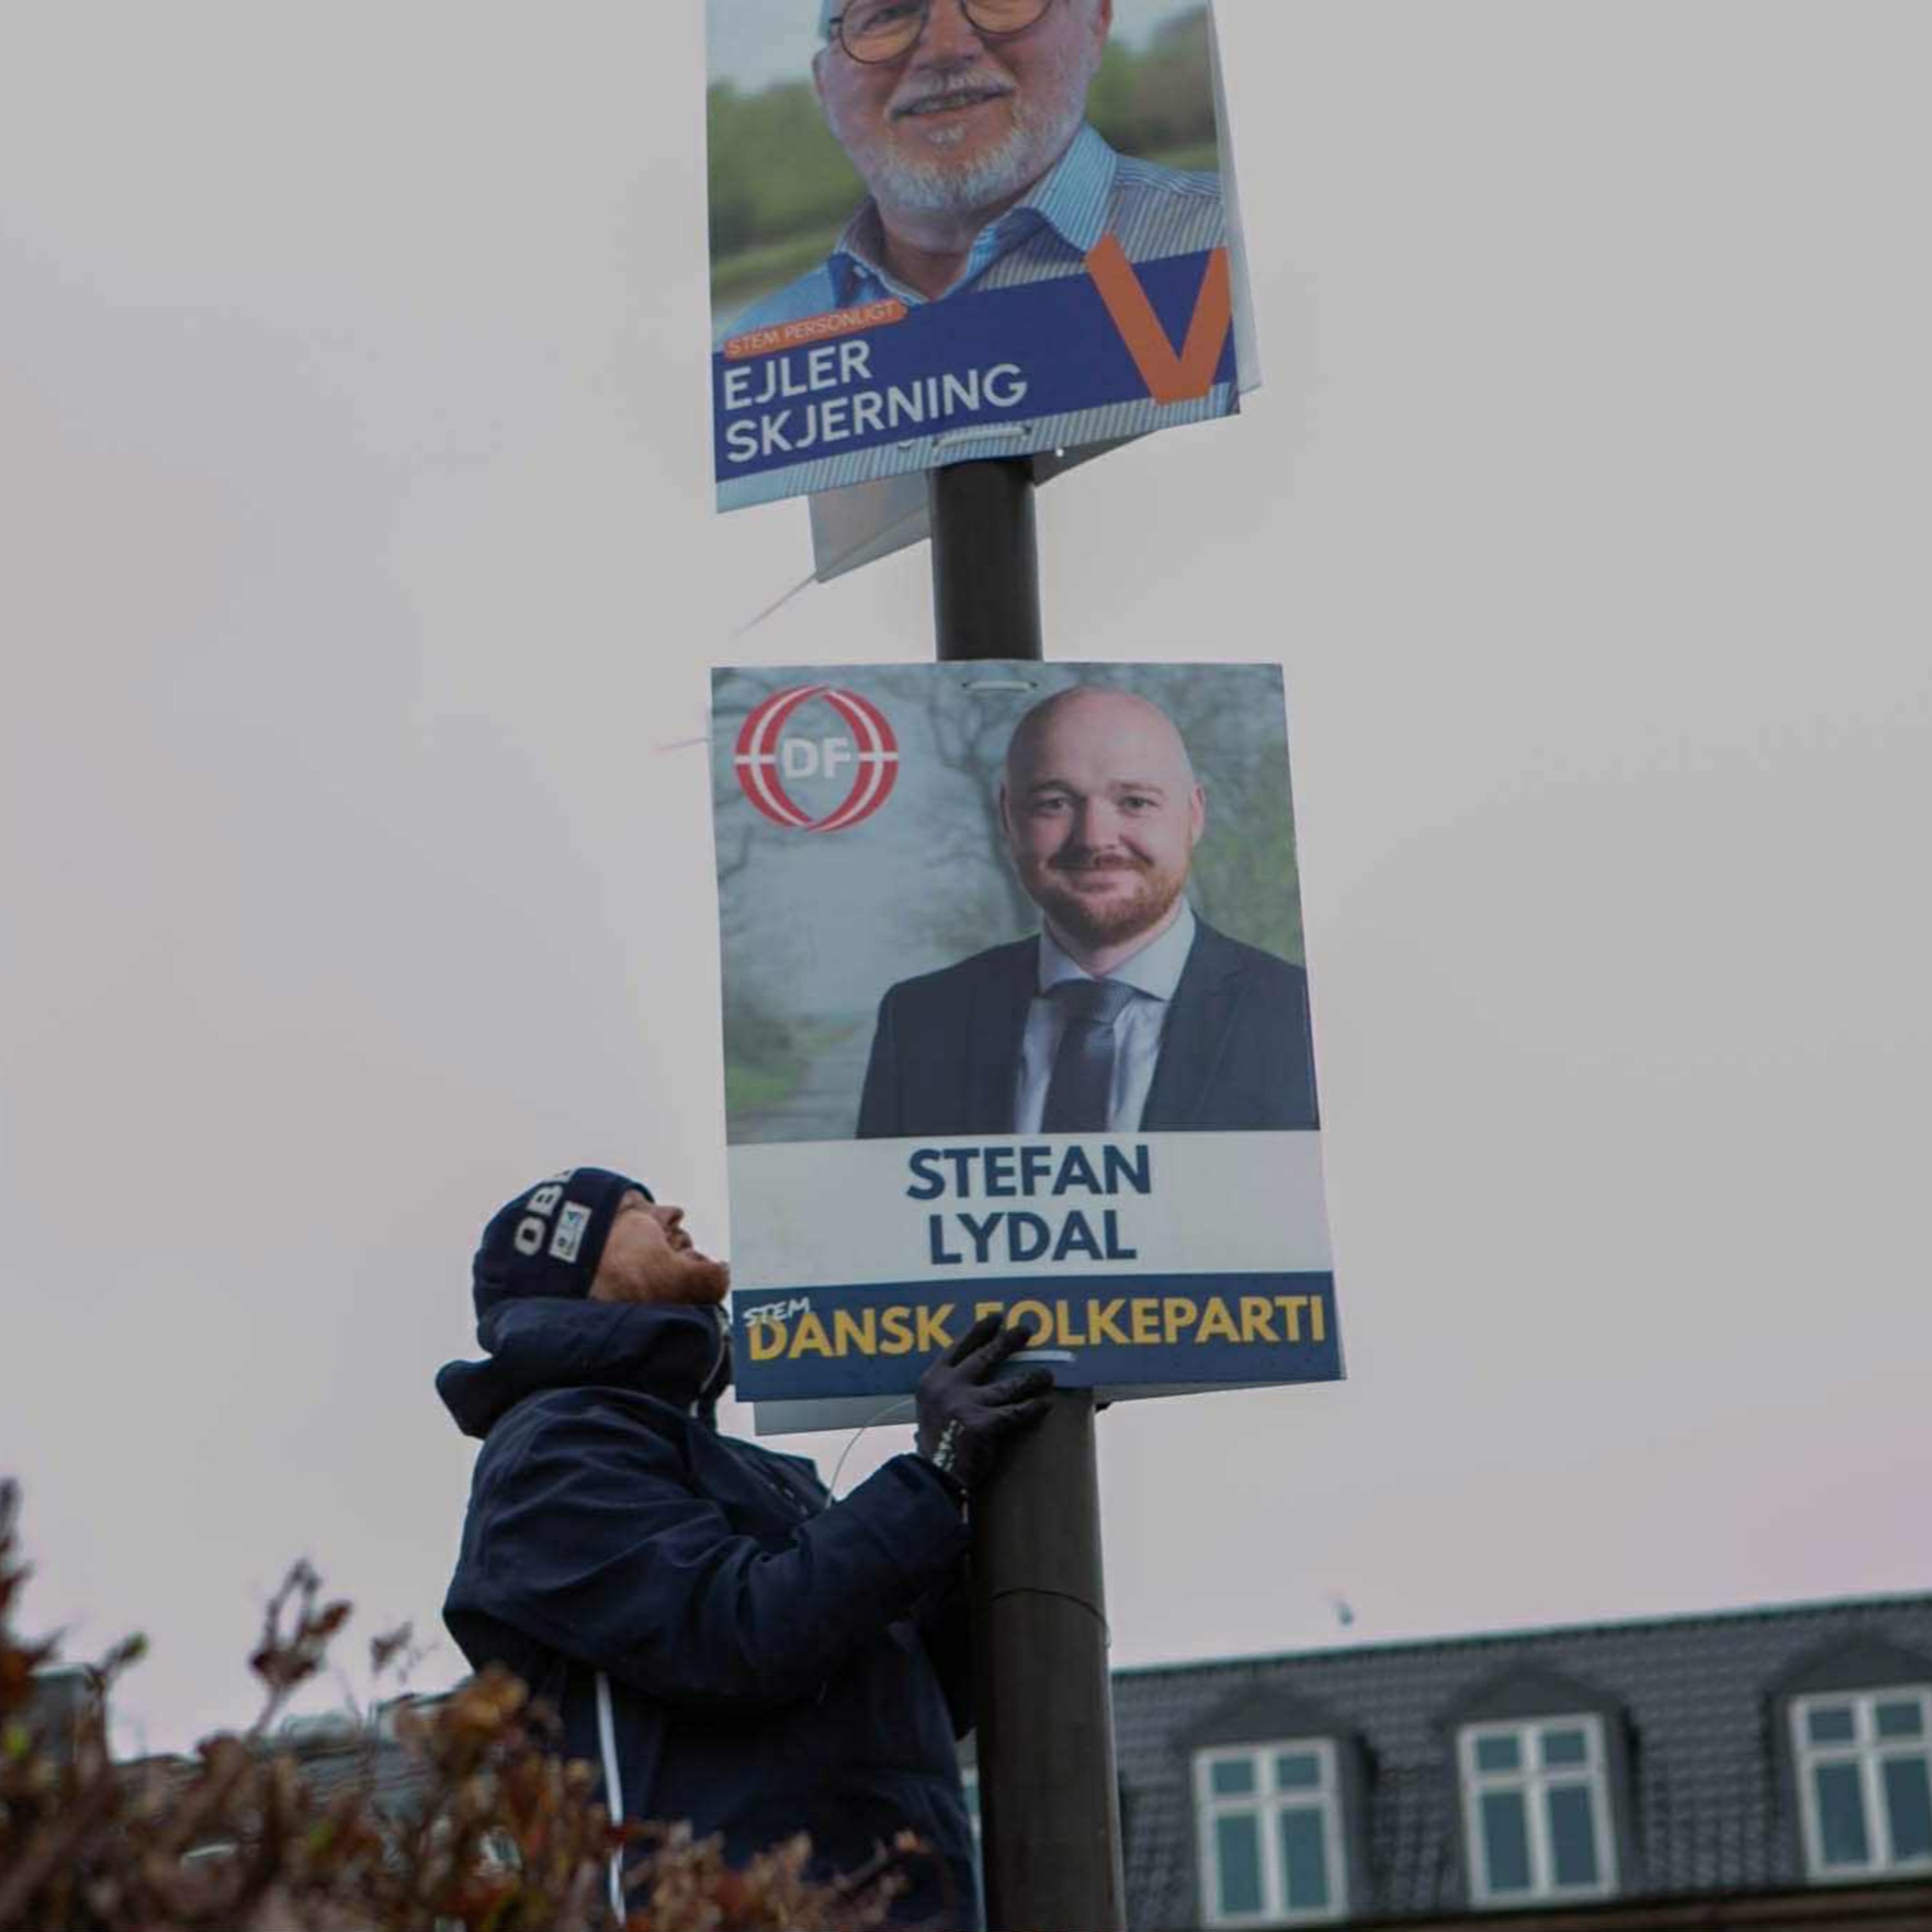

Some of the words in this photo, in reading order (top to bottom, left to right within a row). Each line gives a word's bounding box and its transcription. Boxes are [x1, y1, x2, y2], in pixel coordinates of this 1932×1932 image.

[728, 330, 781, 354] STEM
[784, 303, 896, 339] PERSONLIGT
[1084, 233, 1233, 404] V
[724, 339, 872, 410] EJLER
[725, 363, 1027, 462] SKJERNING
[782, 737, 851, 778] DF
[905, 1144, 1151, 1200] STEFAN
[514, 1168, 574, 1256] OB
[929, 1209, 1137, 1265] LYDAL
[743, 1296, 810, 1327] STEM
[747, 1303, 954, 1360] DANSK
